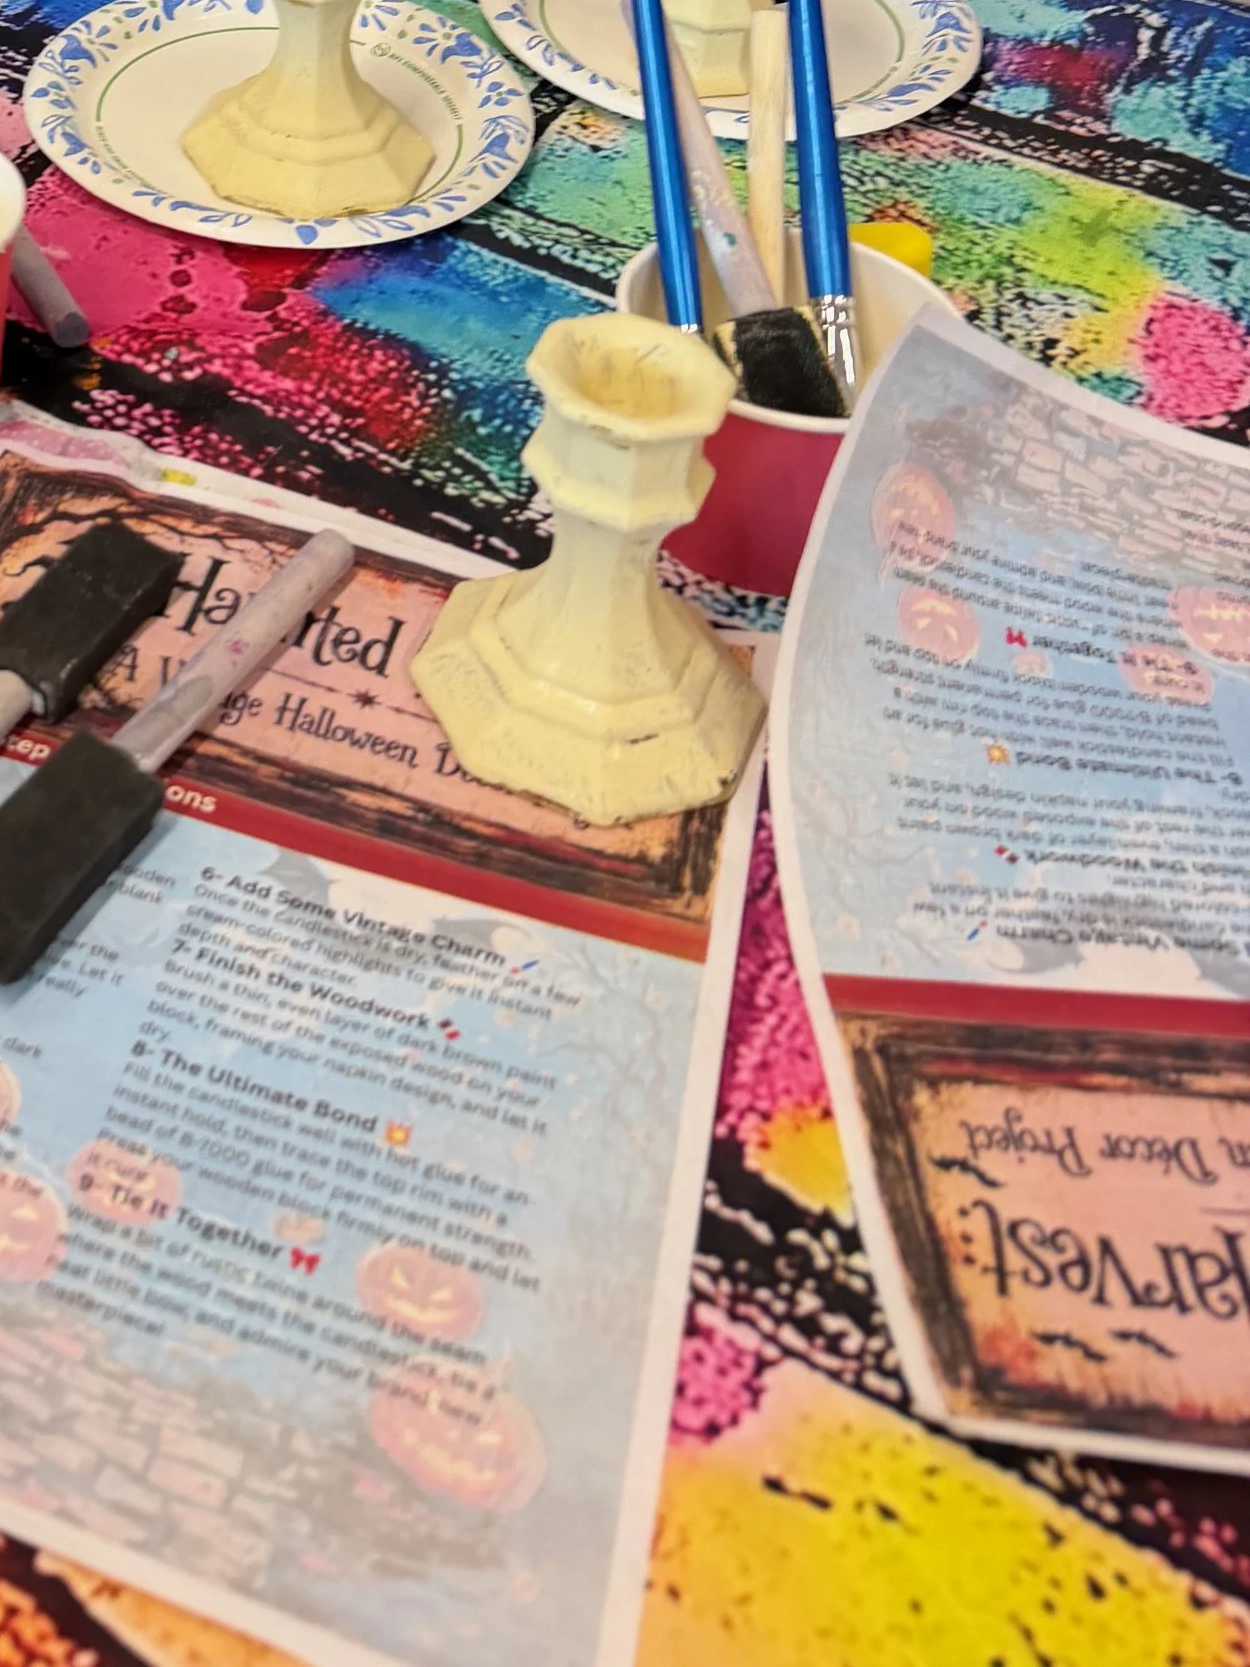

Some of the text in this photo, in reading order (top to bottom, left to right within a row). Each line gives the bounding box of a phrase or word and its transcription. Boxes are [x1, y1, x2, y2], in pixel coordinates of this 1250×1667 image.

[161, 551, 408, 679] Hated
[274, 691, 419, 769] Halloween
[177, 921, 232, 946] depth
[192, 881, 239, 907] Once
[242, 898, 271, 917] the
[199, 864, 506, 965] 6- Add Some Vintage Charm
[162, 958, 217, 986] Brush
[170, 937, 432, 1028] 7- Finish the Woodwork
[129, 1037, 380, 1132] 8- The Ultimate Bond
[959, 1107, 1219, 1185] Décor Project
[172, 1205, 283, 1260] Together
